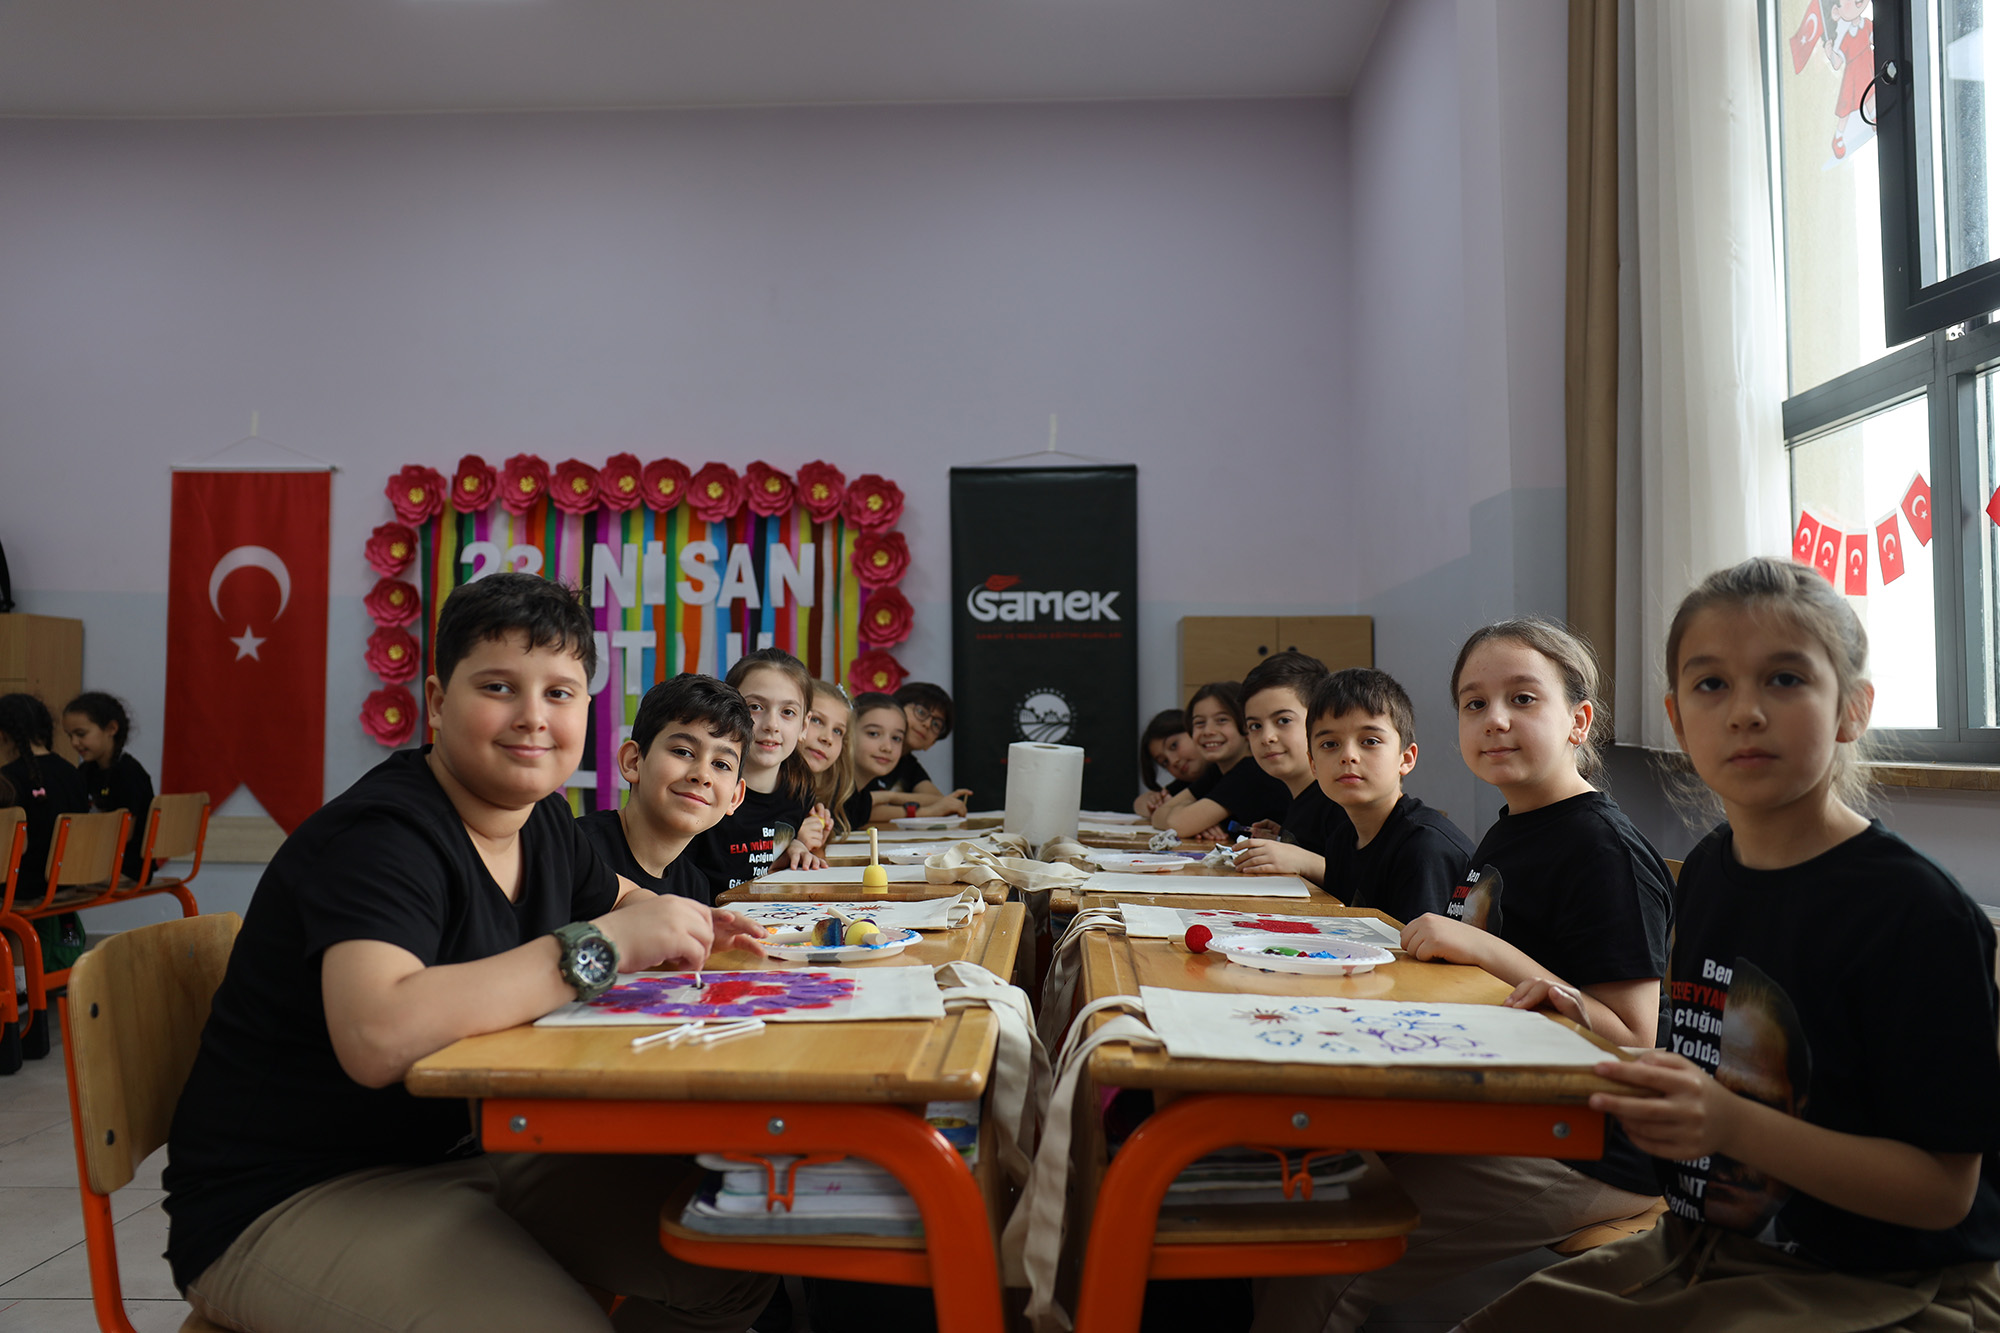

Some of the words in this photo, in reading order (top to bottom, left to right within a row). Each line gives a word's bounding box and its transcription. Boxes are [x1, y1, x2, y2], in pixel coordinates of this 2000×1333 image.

[590, 540, 816, 608] NİSAN
[730, 843, 748, 854] ELA
[1702, 958, 1733, 986] Ben
[1674, 1008, 1723, 1037] çtığın
